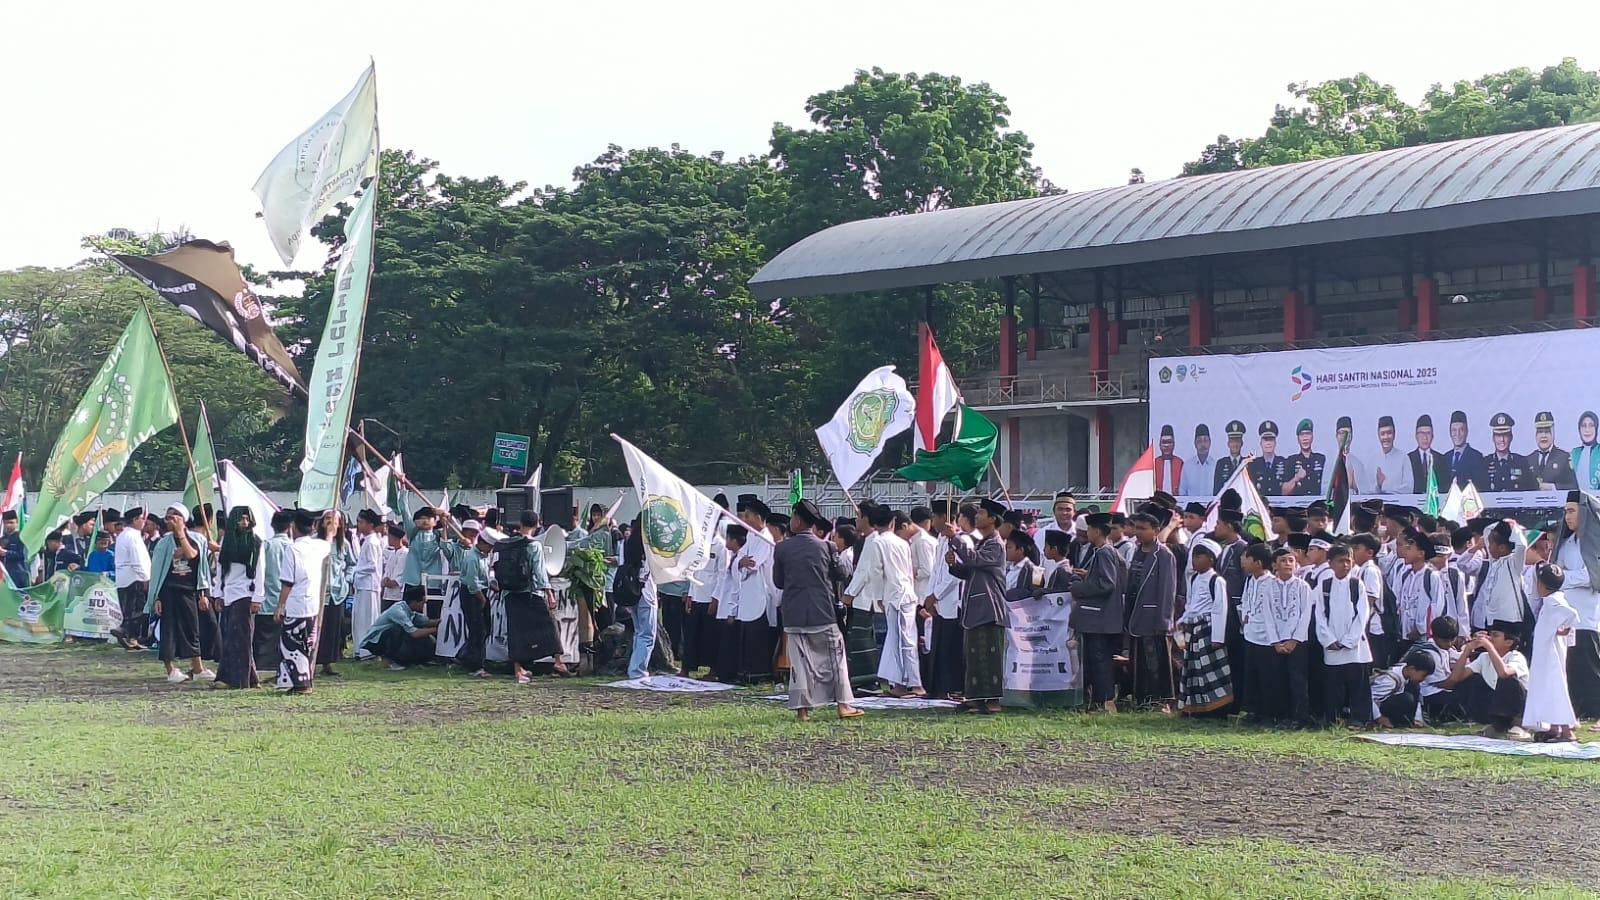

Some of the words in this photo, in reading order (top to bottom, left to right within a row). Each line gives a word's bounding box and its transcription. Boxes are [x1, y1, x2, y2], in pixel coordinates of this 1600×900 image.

[1316, 374, 1336, 384] HARI
[1338, 372, 1369, 383] SANTRI
[1370, 368, 1414, 381] NASIONAL
[1416, 367, 1437, 378] 2025
